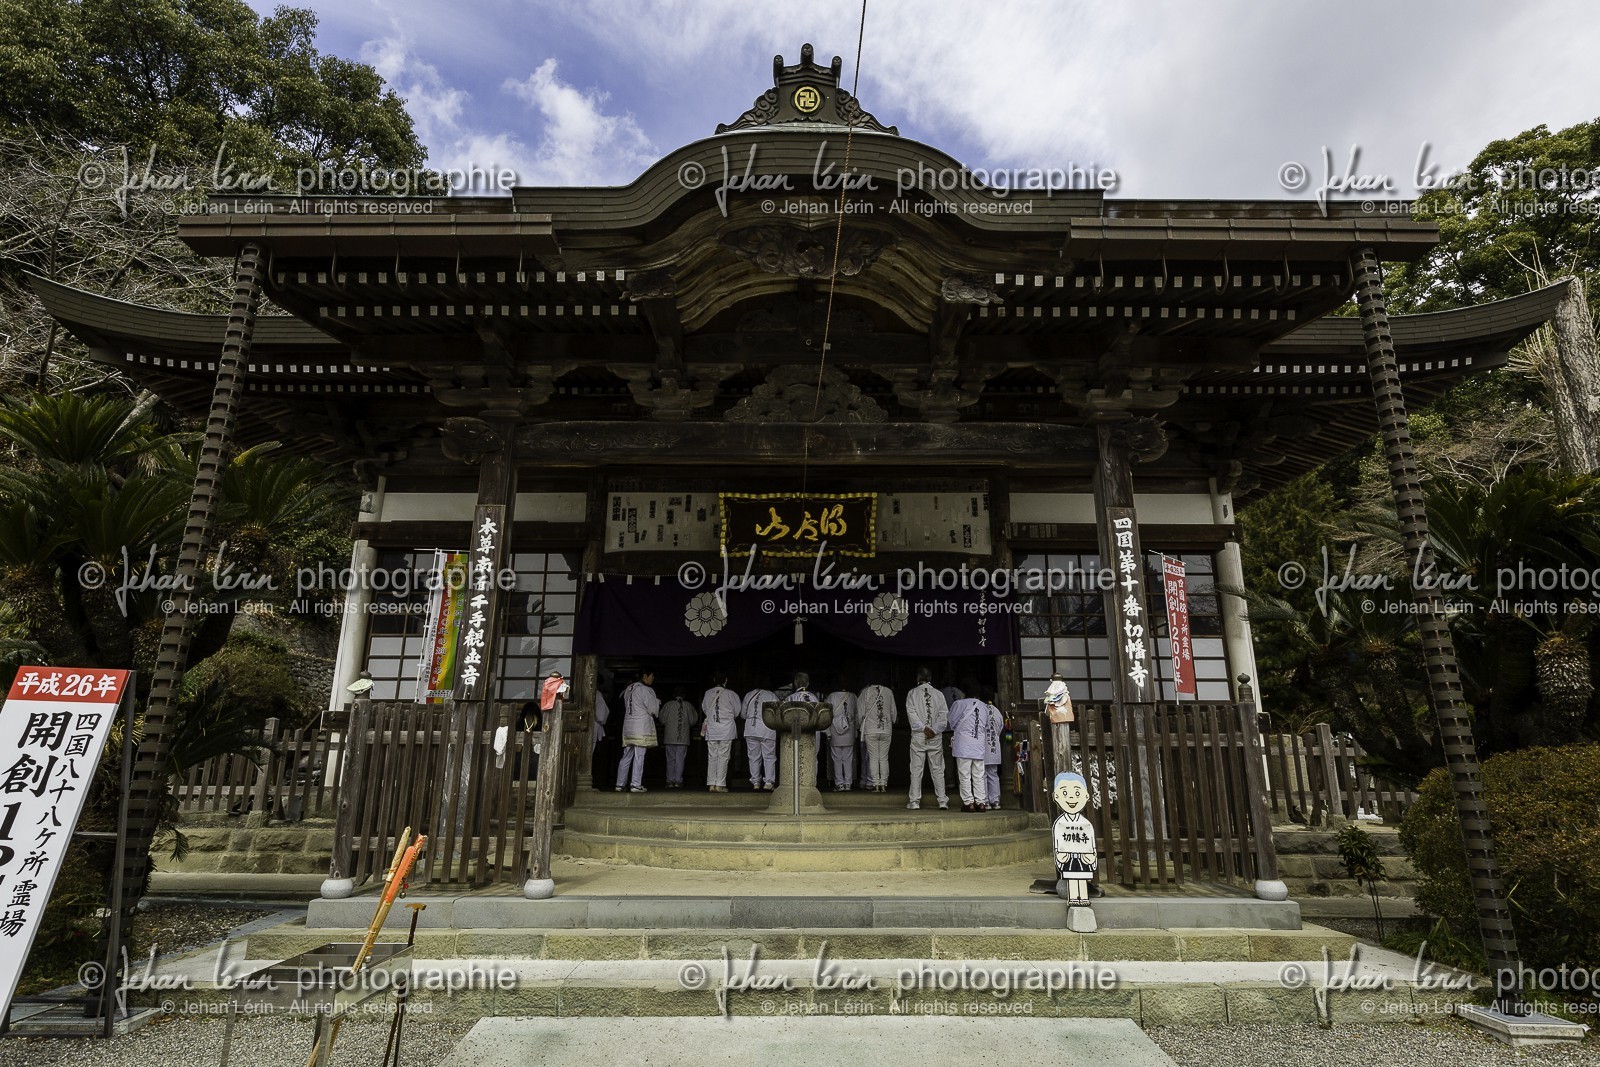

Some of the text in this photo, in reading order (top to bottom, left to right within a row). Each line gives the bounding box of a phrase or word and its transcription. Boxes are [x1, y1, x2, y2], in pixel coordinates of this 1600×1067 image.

[1113, 517, 1149, 688] 四国第十番切幡寺
[17, 672, 118, 698] 平成26年
[1062, 832, 1089, 844] 切幡寺
